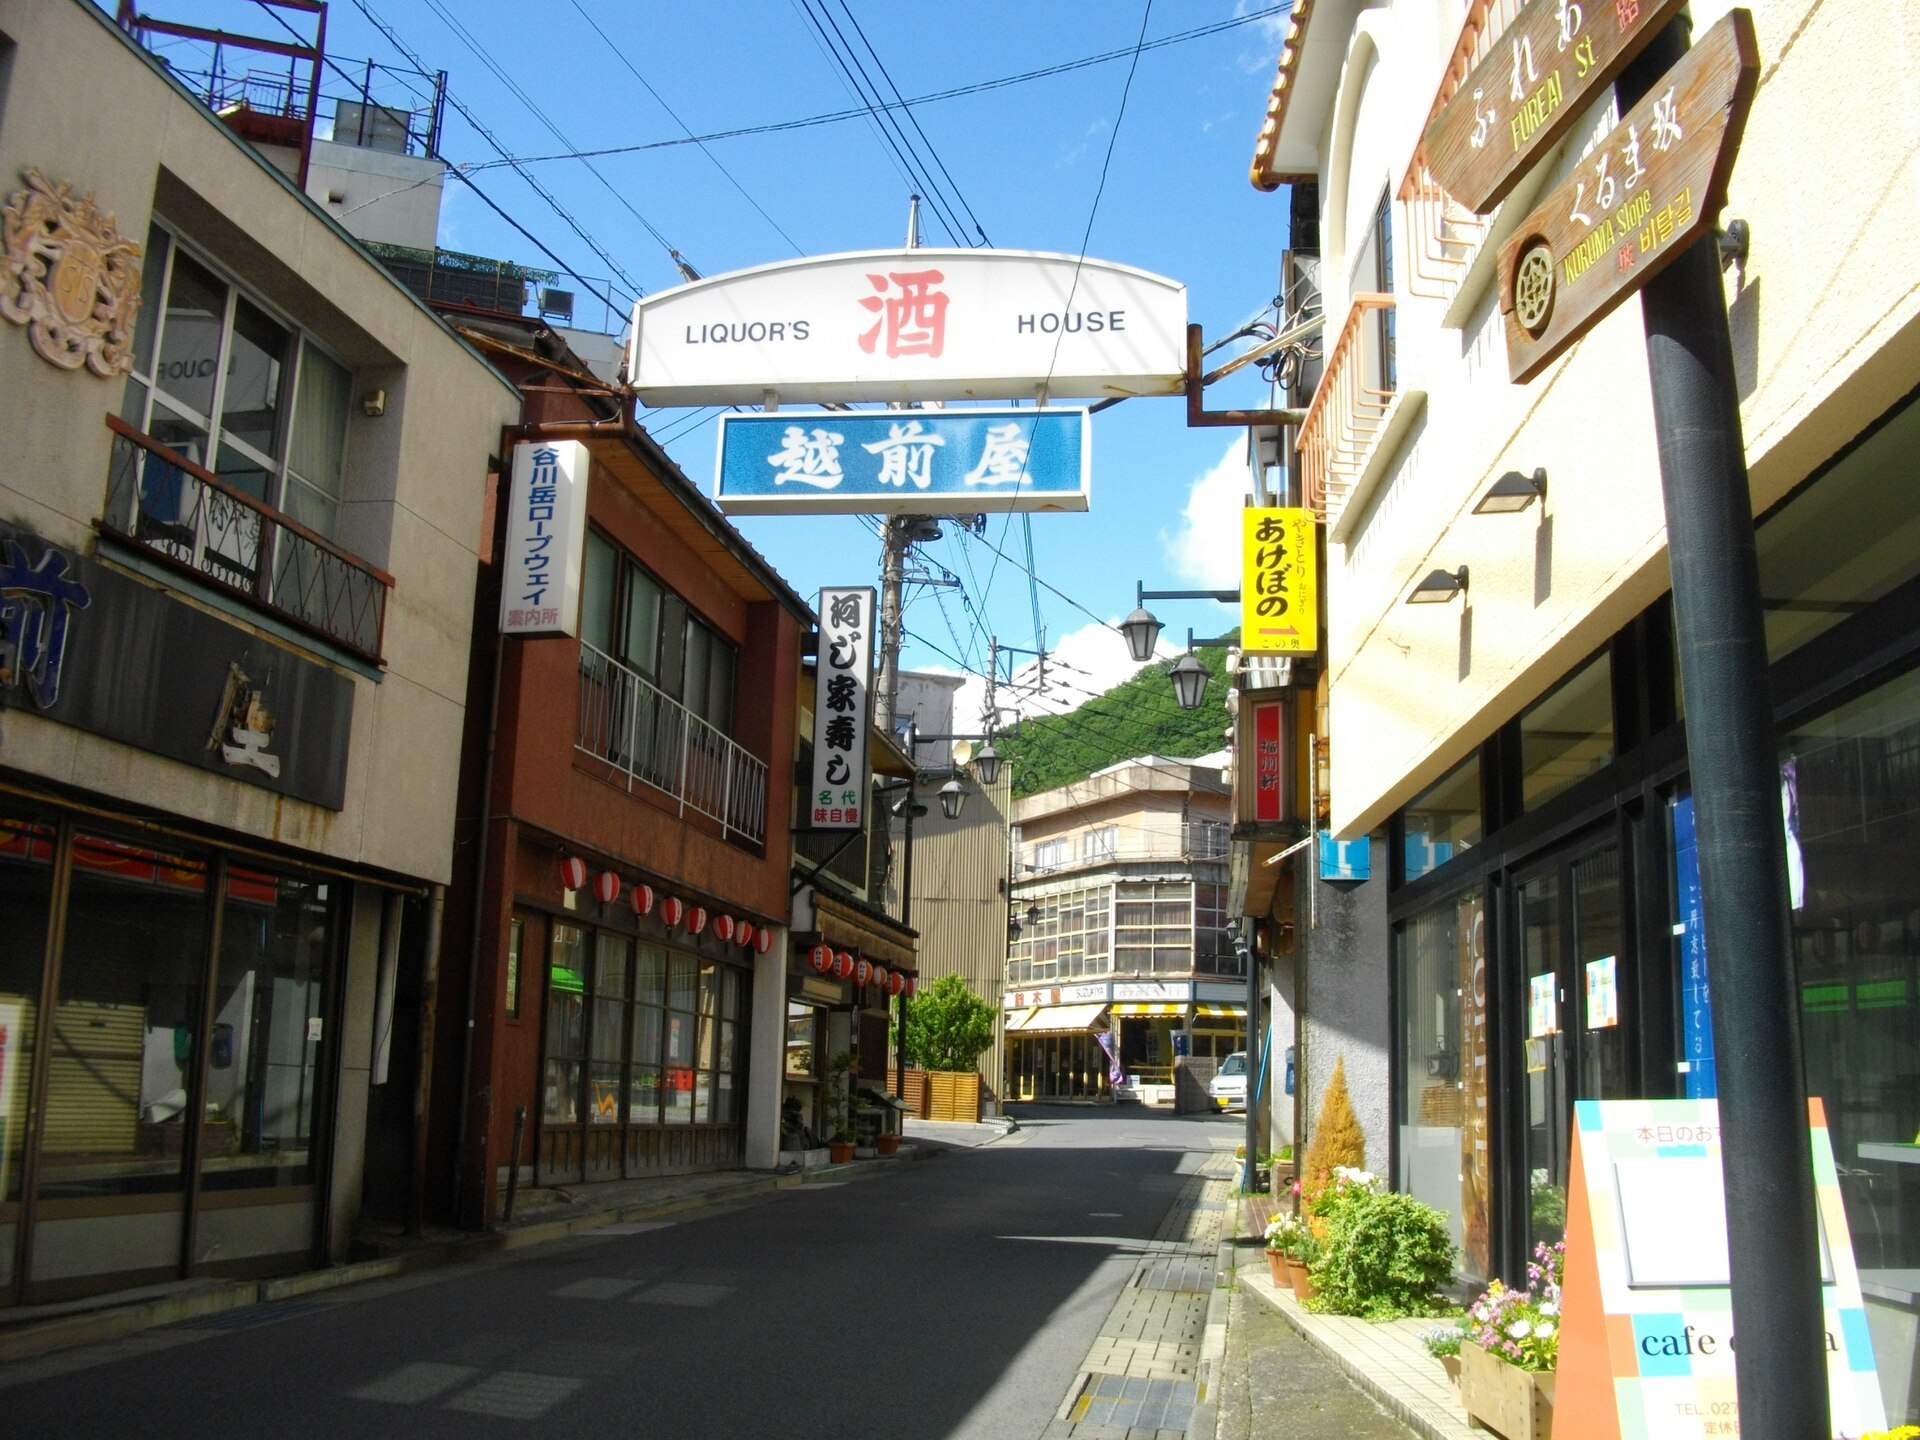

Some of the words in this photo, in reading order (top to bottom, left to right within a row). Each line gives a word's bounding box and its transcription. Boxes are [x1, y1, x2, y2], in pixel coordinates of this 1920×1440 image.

[1511, 70, 1563, 152] FUREAI
[1563, 218, 1615, 287] KURUMA
[1616, 189, 1652, 237] Slope
[685, 320, 810, 345] LIQUOR'S
[858, 269, 950, 359] 酒
[1017, 310, 1126, 335] HOUSE
[767, 423, 1033, 490] 越前屋
[522, 447, 560, 606] 谷川岳ロープウェイ
[1255, 516, 1292, 617] あけぼの
[507, 607, 559, 627] 案内所
[814, 808, 857, 823] 味自慢
[818, 790, 856, 805] 名代
[1641, 1325, 1717, 1356] cafe
